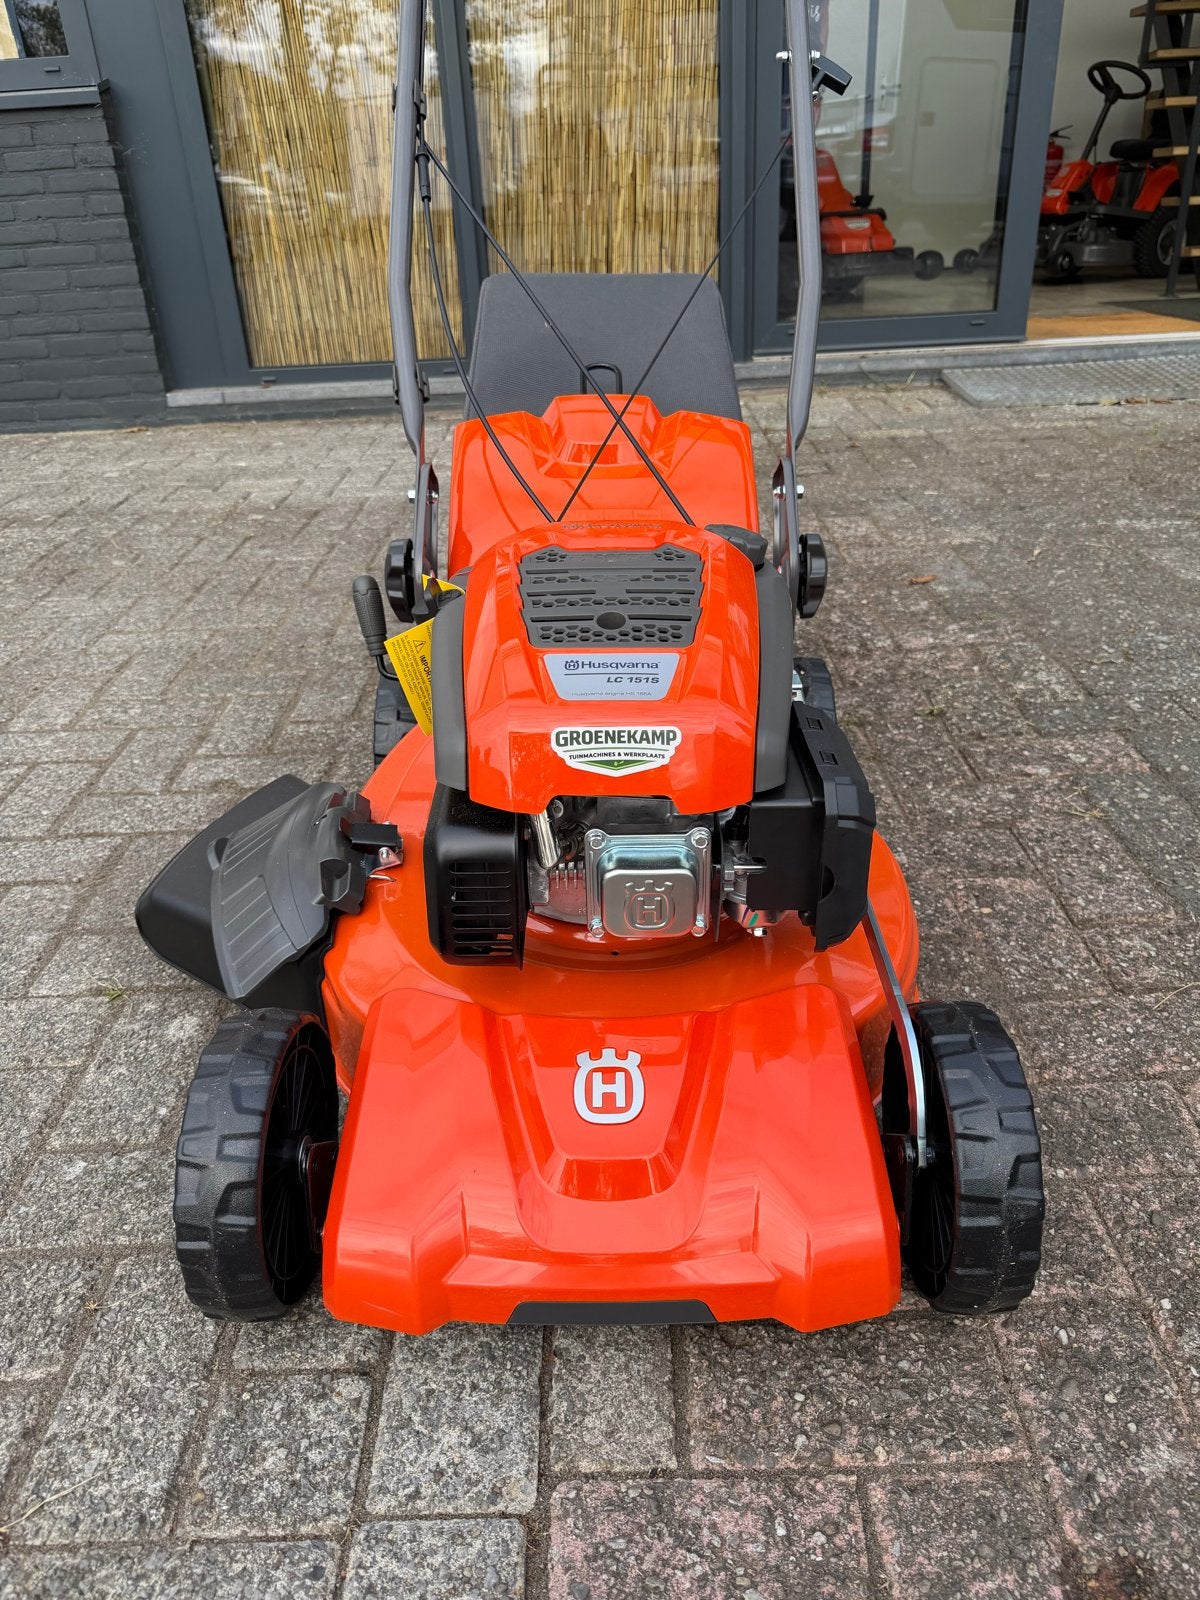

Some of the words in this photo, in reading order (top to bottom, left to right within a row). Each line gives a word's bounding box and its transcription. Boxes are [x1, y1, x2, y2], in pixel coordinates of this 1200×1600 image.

[581, 661, 659, 670] Husqvarna
[606, 676, 623, 684] LC
[627, 676, 660, 684] 151S
[555, 729, 677, 747] GROENEKAMP
[568, 751, 616, 760] TUINMACHINES
[623, 751, 666, 760] WERKPLAATS
